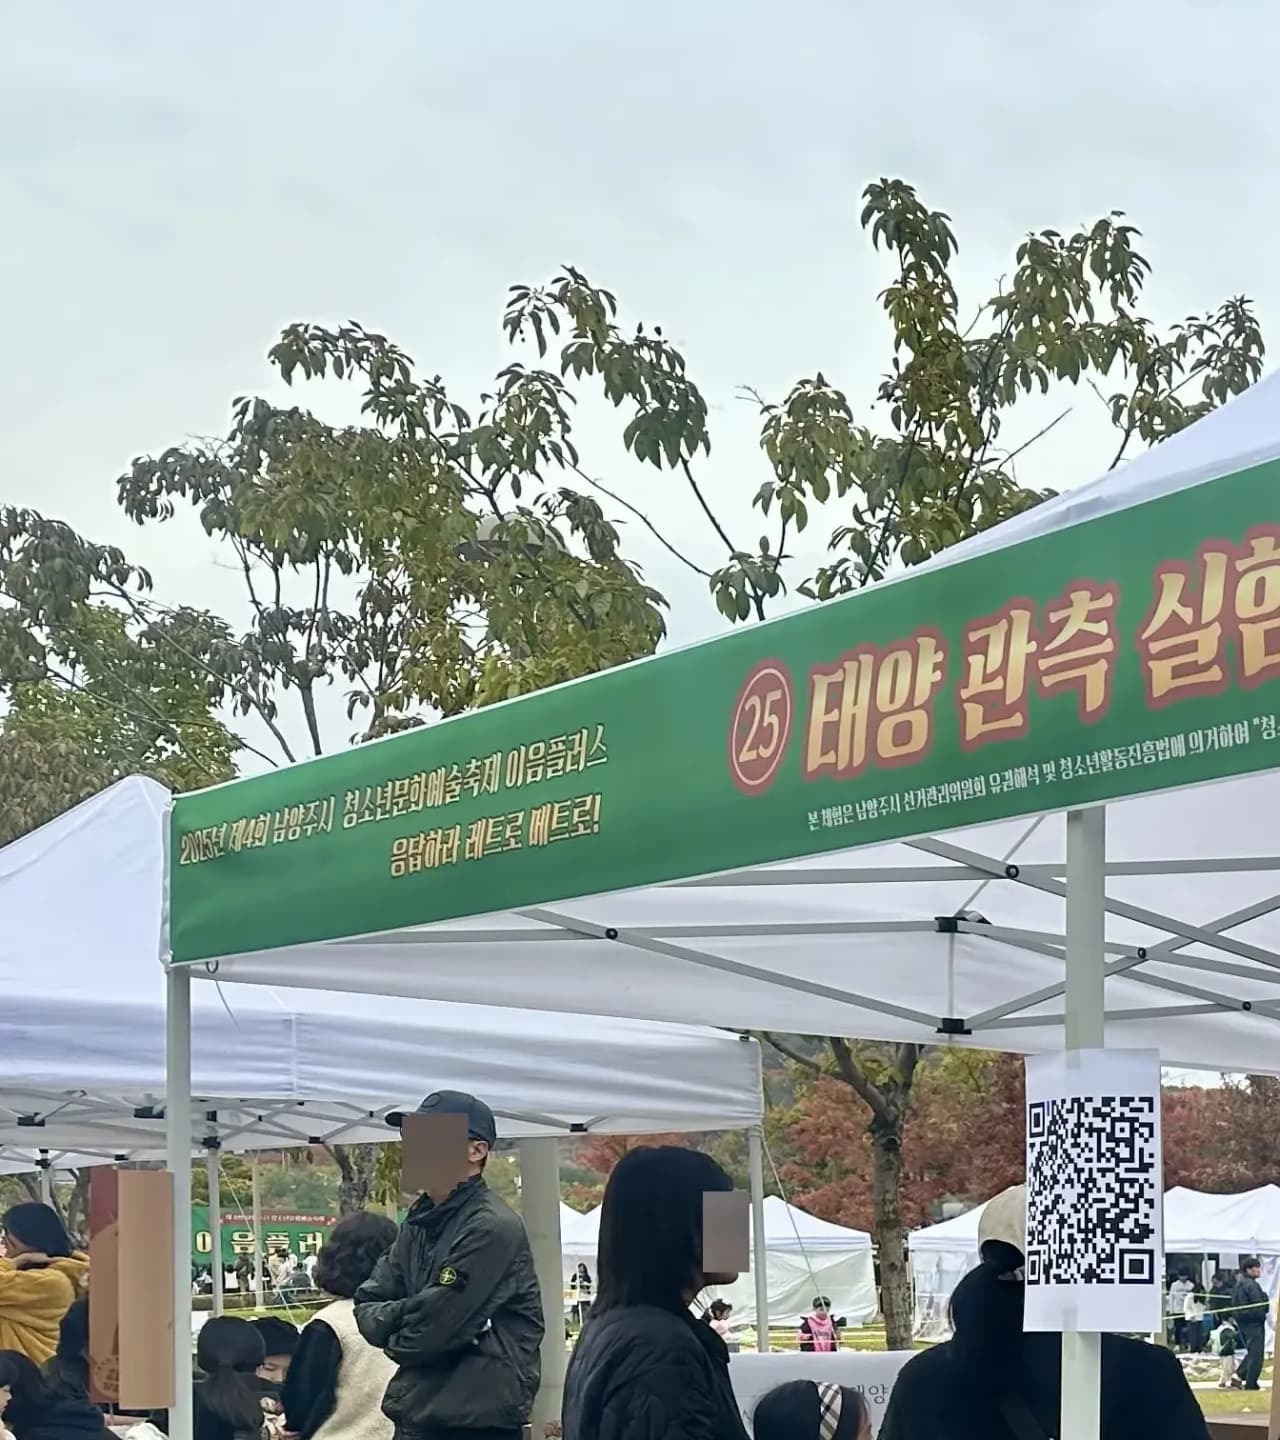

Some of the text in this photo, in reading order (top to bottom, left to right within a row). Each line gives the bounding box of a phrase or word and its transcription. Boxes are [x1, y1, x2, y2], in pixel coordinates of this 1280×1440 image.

[807, 636, 943, 773] 태양
[960, 590, 1114, 741] 관측
[180, 724, 608, 865] 2025년 제4회 남양주시 청소년문화예술축제 이음플러스
[390, 794, 602, 878] 응답하라 레트로 메트로!
[807, 810, 820, 831] 본
[821, 805, 854, 827] 체험은
[855, 793, 901, 821] 남양주시
[903, 776, 987, 812] 선거관리위원회
[989, 764, 1040, 793] 유권해석
[1042, 760, 1056, 784] 및
[1059, 733, 1186, 780] 청소년활동진흥법에
[1188, 720, 1250, 754] 의거하여
